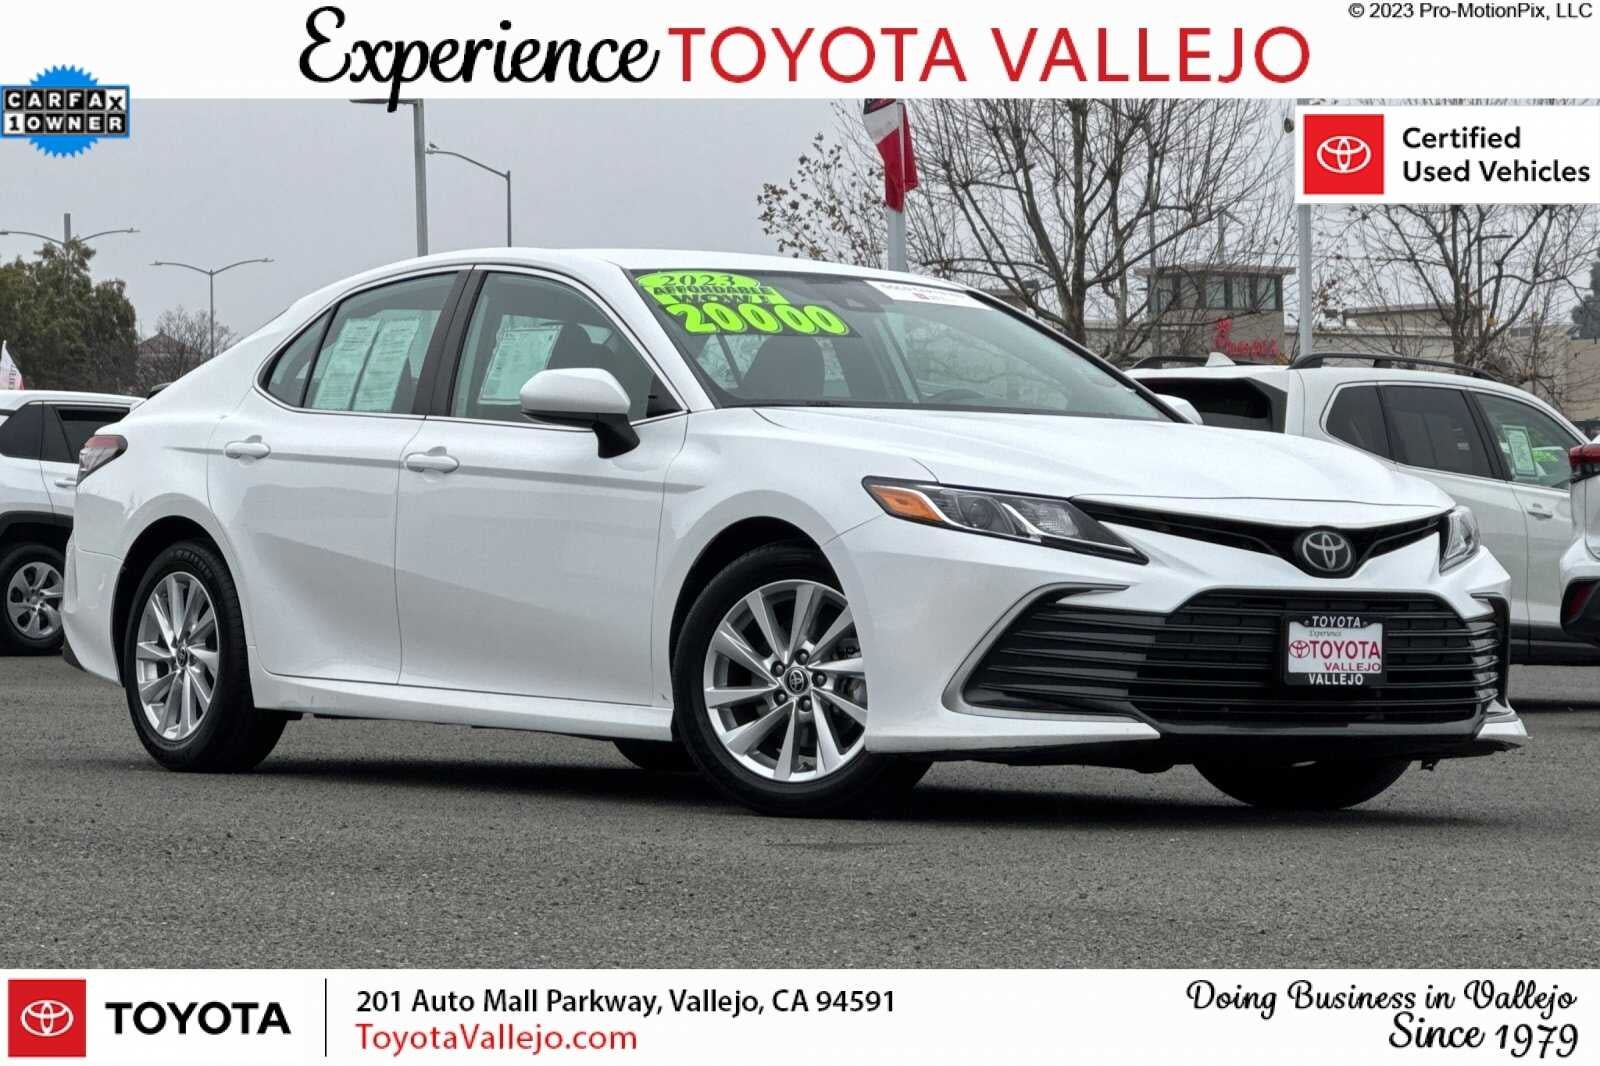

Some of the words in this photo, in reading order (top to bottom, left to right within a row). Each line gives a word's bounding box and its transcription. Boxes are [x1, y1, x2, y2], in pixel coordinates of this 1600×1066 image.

[659, 274, 736, 286] 2023
[666, 303, 849, 335] 20000
[1312, 616, 1361, 628] TOYOTA
[1310, 640, 1381, 659] TOYOTA
[1325, 662, 1381, 672] VALLEJO
[1308, 674, 1364, 685] VALLEJO
